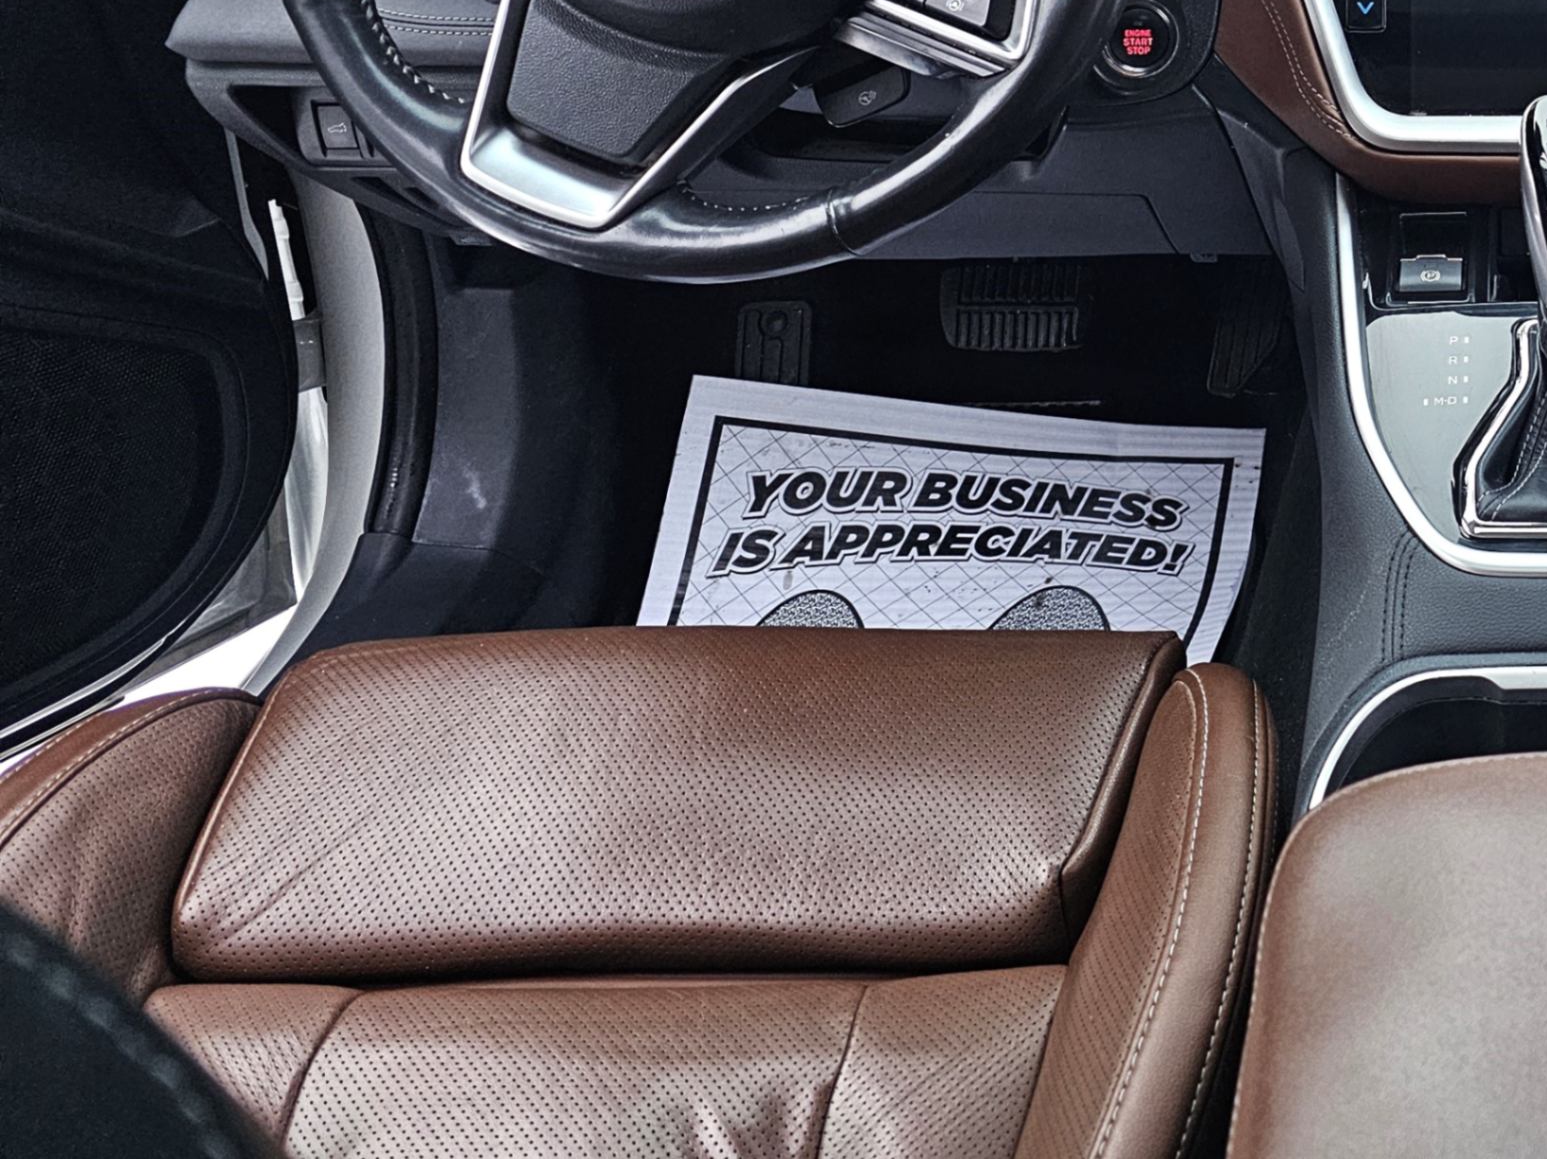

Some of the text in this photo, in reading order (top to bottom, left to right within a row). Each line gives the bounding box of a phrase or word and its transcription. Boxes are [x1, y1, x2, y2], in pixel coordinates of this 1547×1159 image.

[1124, 29, 1152, 37] ENGINE
[1123, 37, 1153, 47] START
[1126, 46, 1151, 55] STOP
[1449, 336, 1459, 345] P
[1448, 356, 1458, 365] R
[1448, 376, 1458, 385] N
[747, 468, 1187, 530] YOUR BUSINESS
[708, 523, 1193, 576] IS APPRECIATED!
